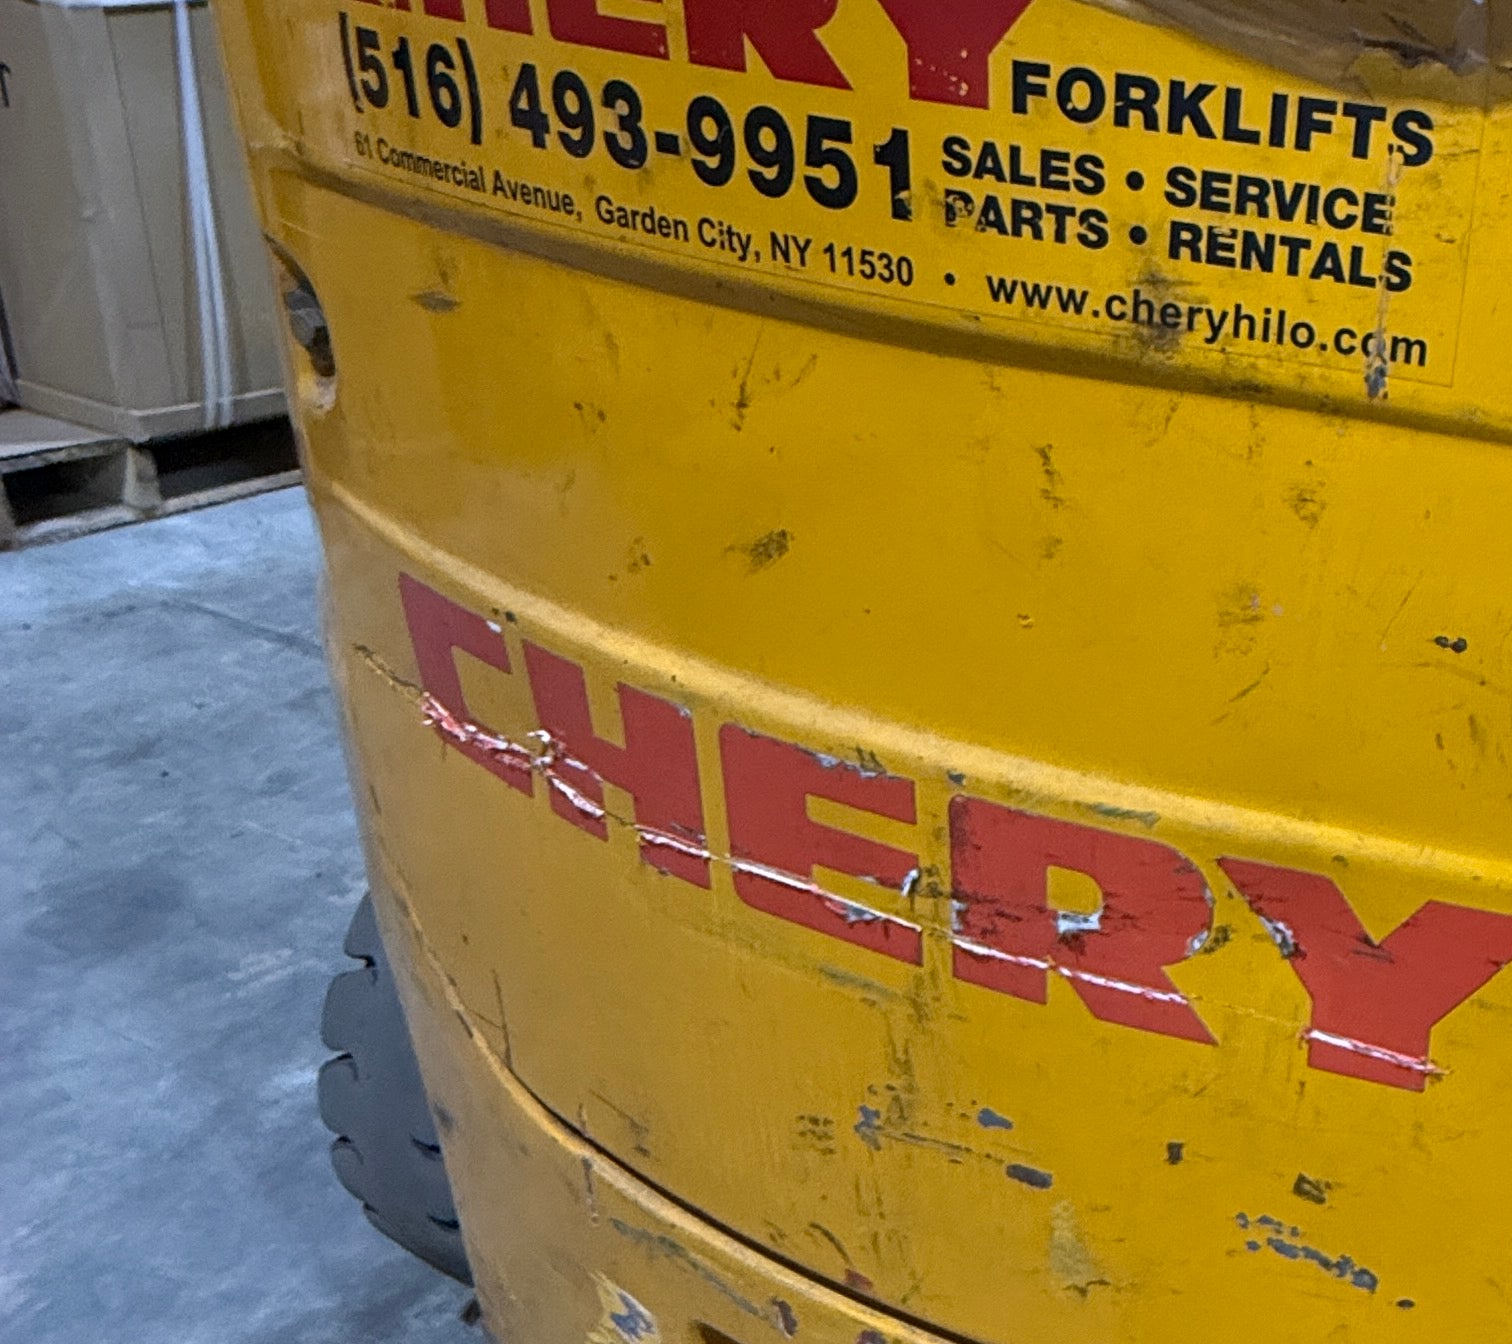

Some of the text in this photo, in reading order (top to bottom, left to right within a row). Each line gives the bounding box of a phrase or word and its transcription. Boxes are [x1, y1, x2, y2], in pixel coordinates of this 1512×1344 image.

[338, 11, 914, 223] (516) 493-9951
[1010, 59, 1435, 167] FORKLIFTS
[353, 130, 373, 160] 61
[376, 137, 487, 193] Commercial
[491, 169, 582, 223] Avenue,
[594, 194, 690, 243] Garden
[697, 217, 761, 264] City,
[769, 230, 813, 267] NY
[822, 241, 914, 287] 11530
[941, 135, 1397, 236] SALES SERVICE
[943, 188, 1413, 293] PARTS RENTALS
